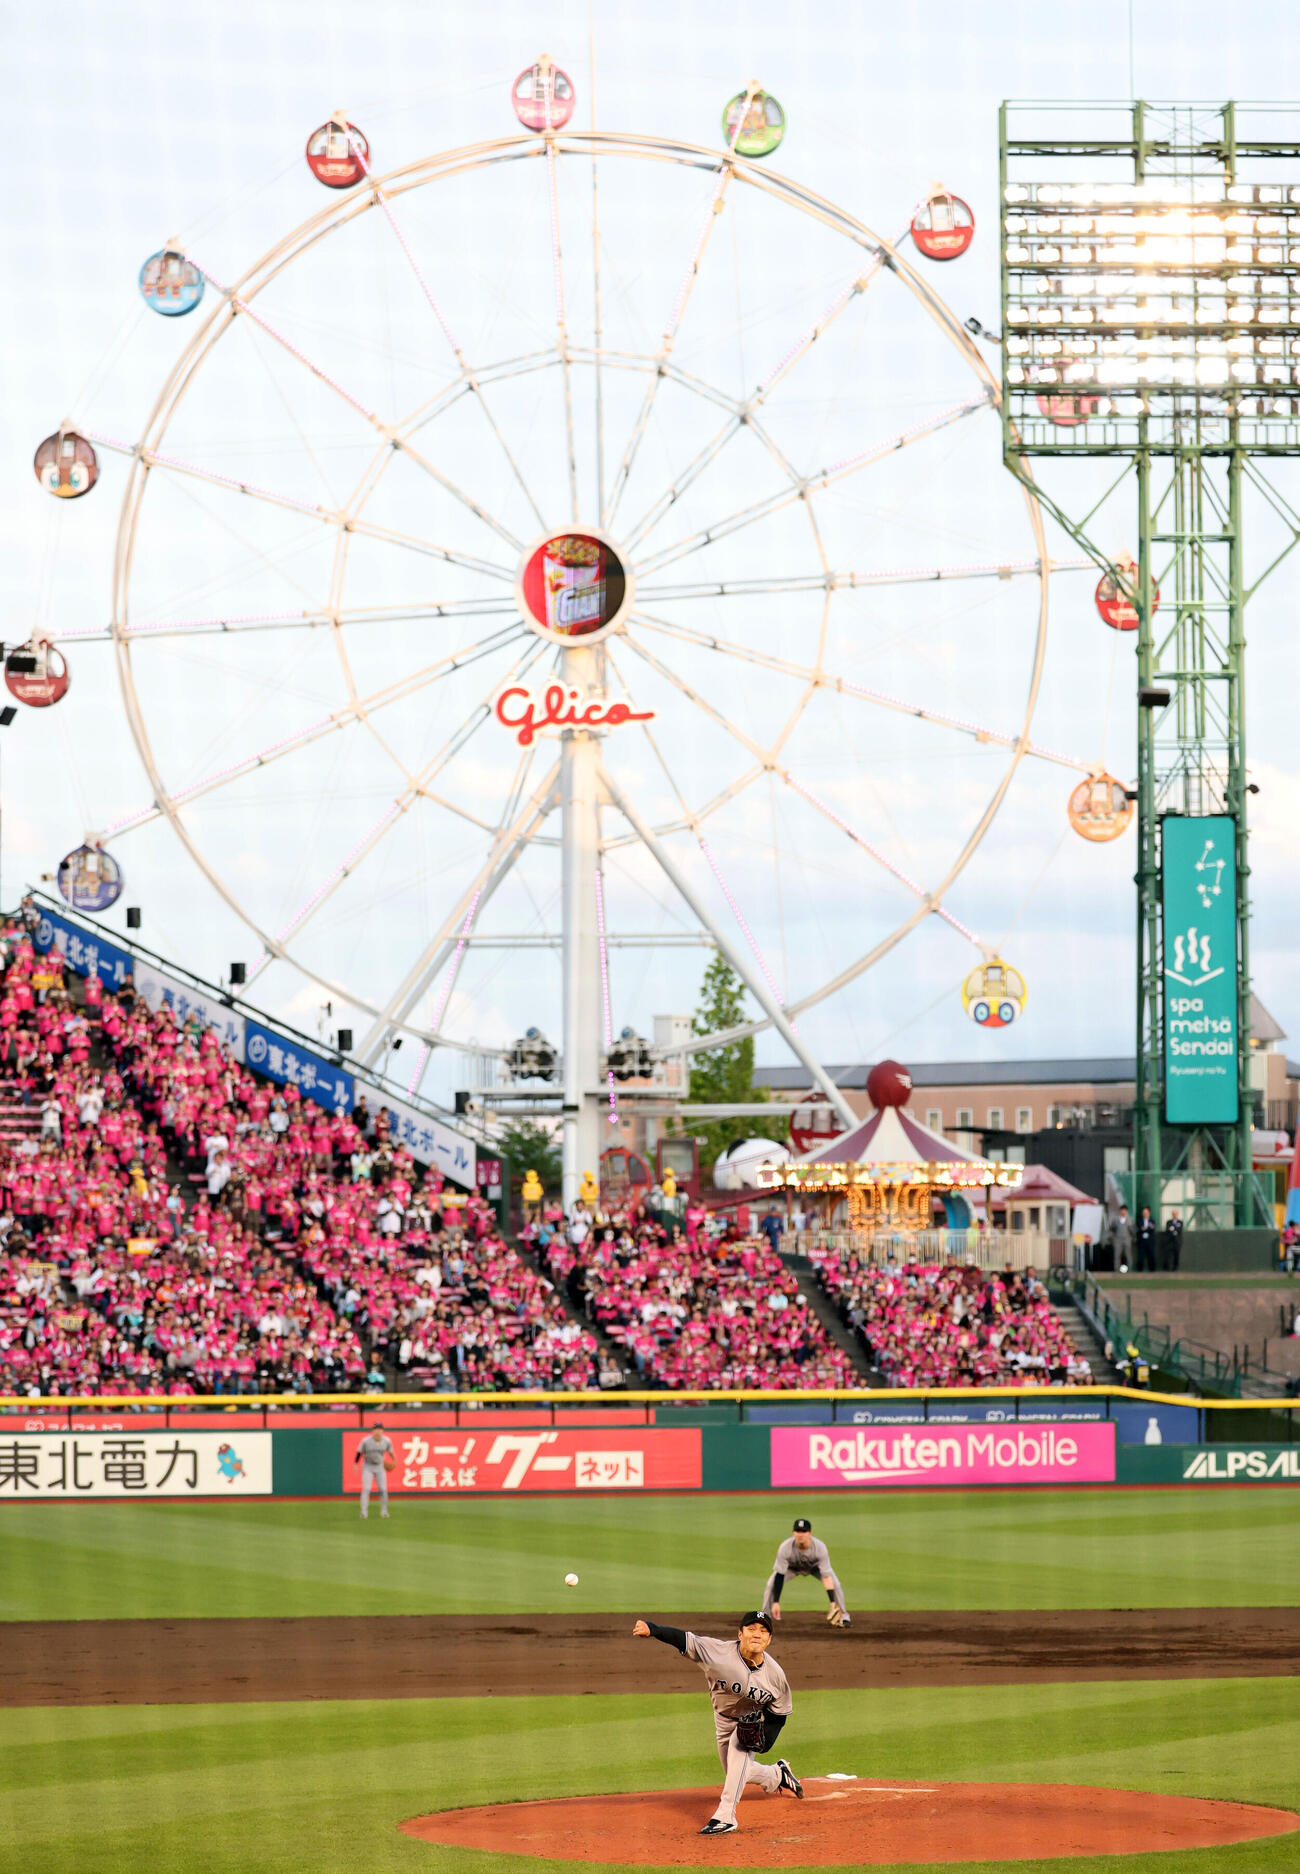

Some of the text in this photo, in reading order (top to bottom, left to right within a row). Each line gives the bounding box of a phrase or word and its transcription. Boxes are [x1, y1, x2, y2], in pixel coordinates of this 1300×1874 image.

[496, 685, 655, 746] Glico
[1170, 998, 1203, 1016] spa
[1169, 1036, 1234, 1056] Sendai
[268, 1044, 350, 1106] 東北ボール
[388, 1108, 468, 1171] 東北ボール
[0, 1439, 199, 1490] 東北電力
[484, 1432, 640, 1489] グー ネット
[808, 1430, 1079, 1470] Rakuten Mobile
[401, 1466, 479, 1488] と言えば
